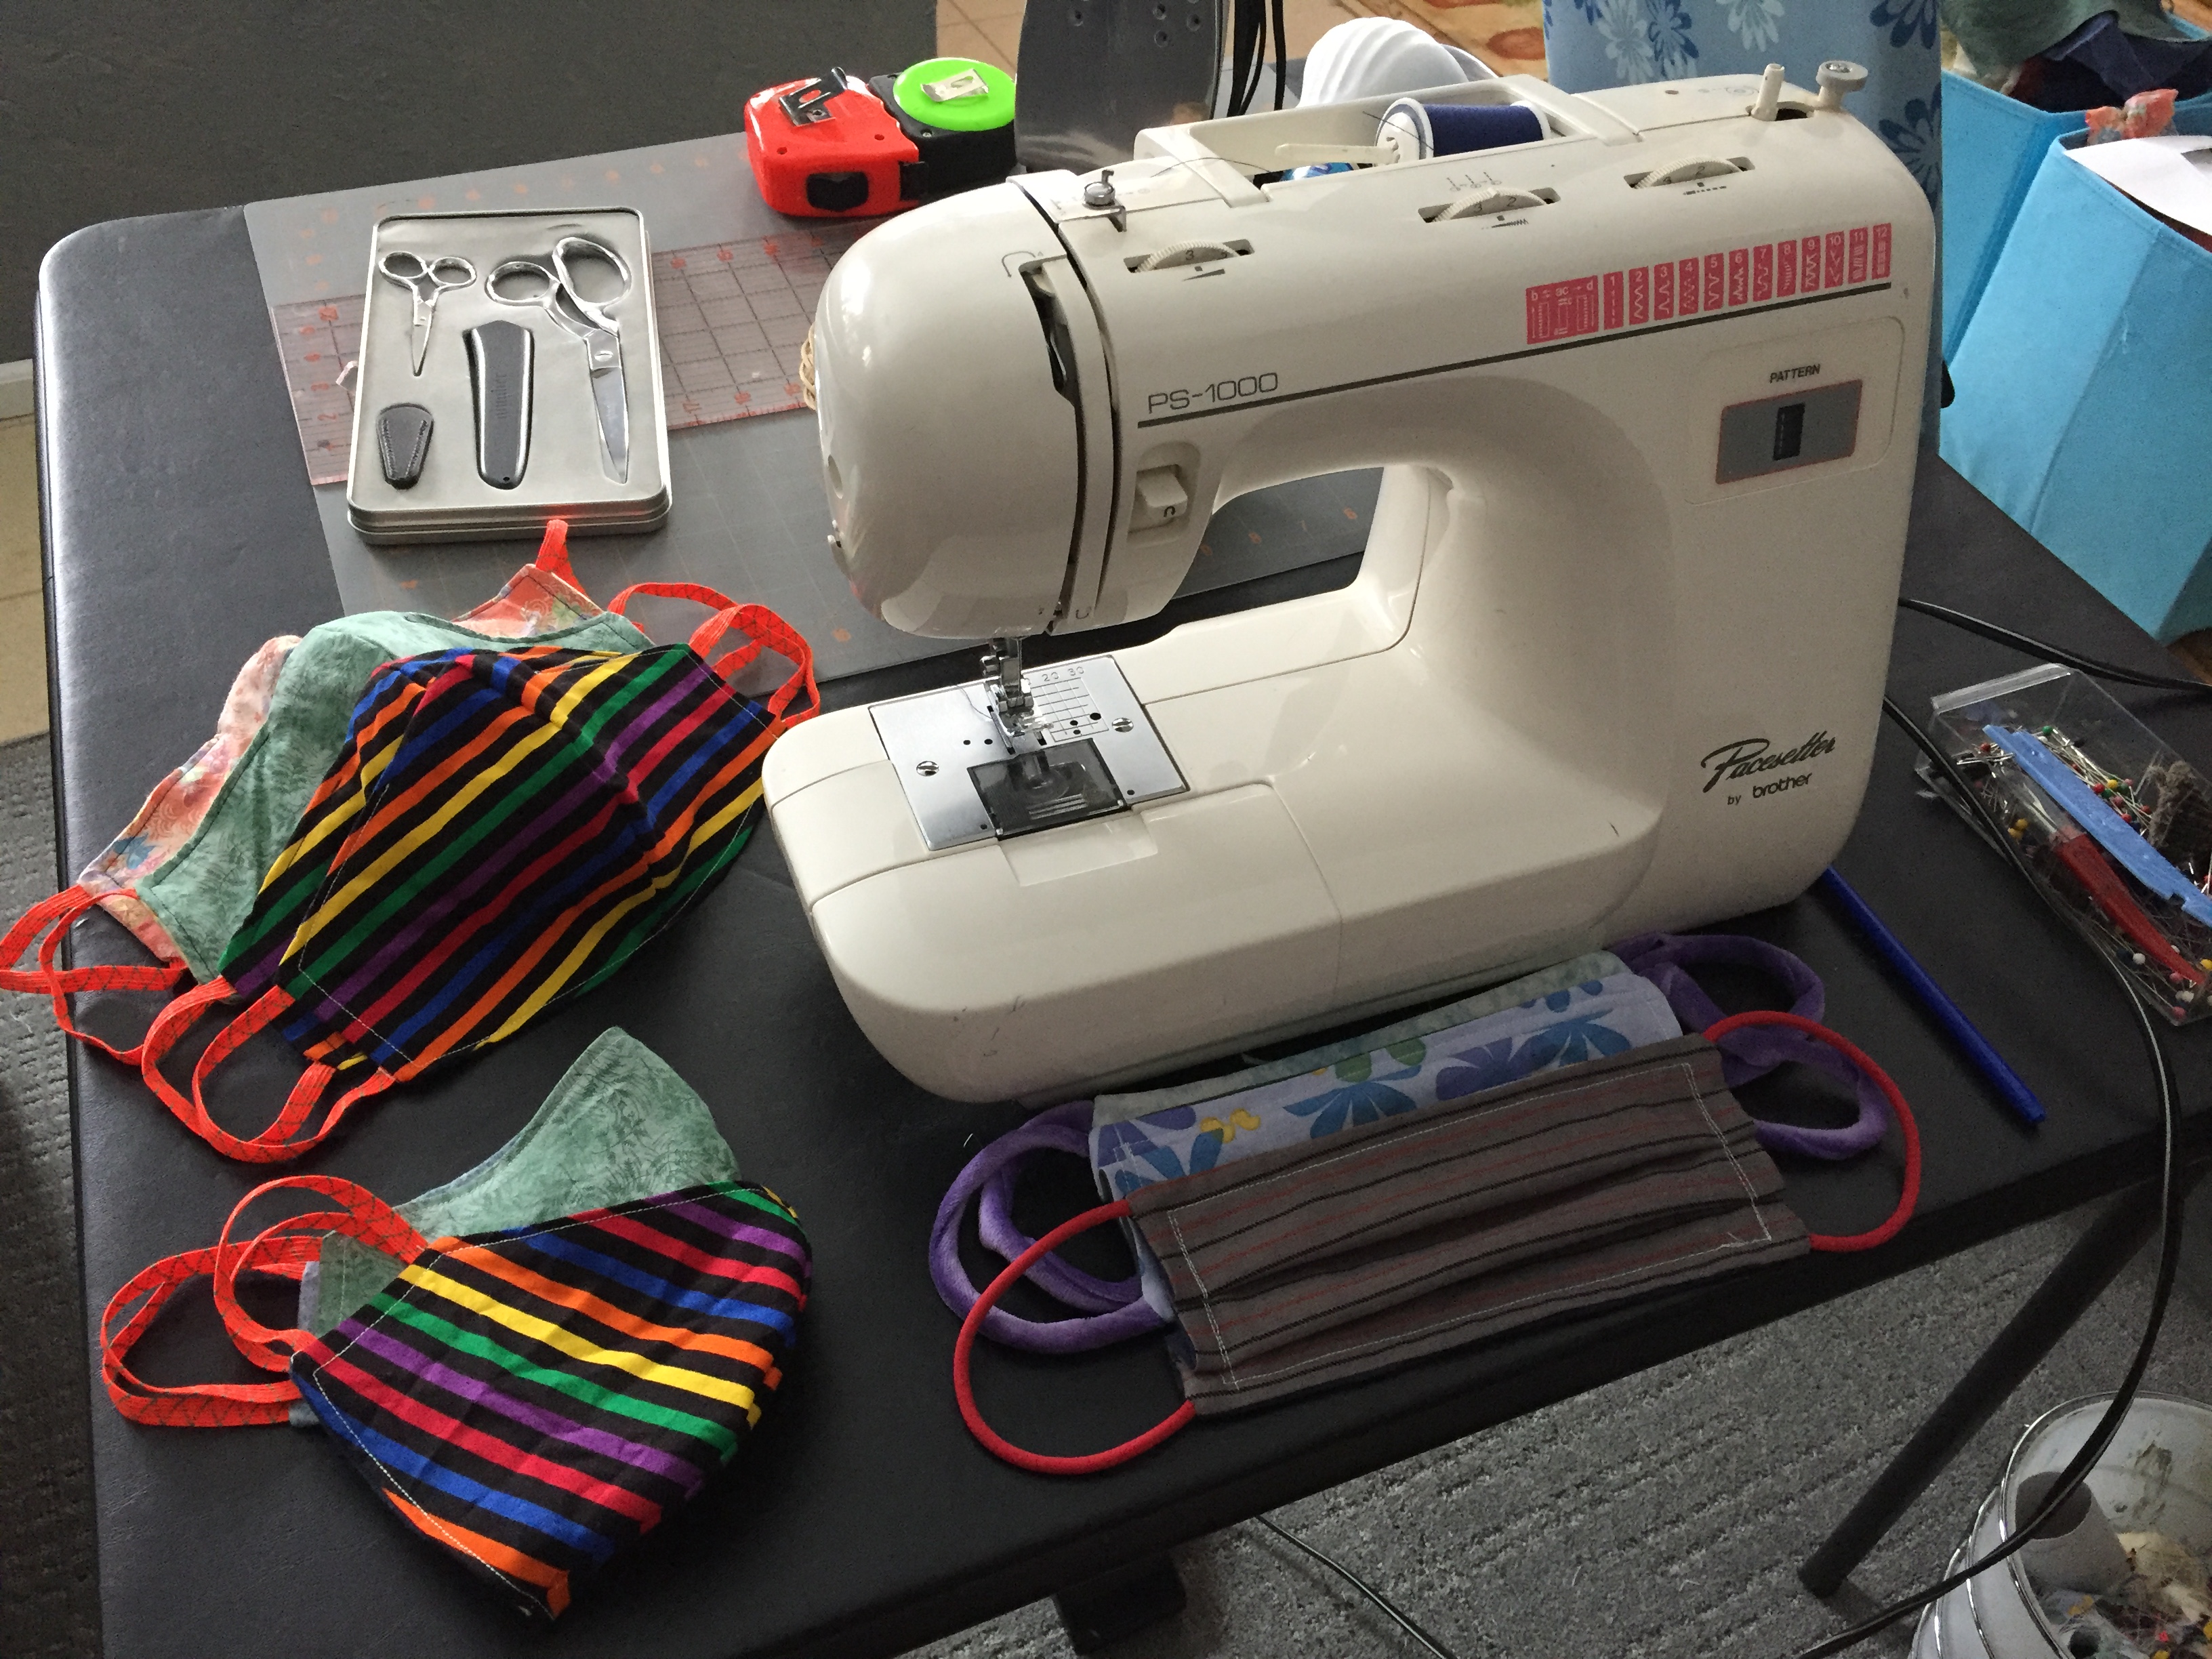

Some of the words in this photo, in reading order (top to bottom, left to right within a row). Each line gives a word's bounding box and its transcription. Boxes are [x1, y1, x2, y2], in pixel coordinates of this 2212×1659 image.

[1696, 165, 1705, 176] 2
[1474, 201, 1483, 214] 3
[1507, 195, 1517, 207] 2
[1185, 249, 1194, 261] 3
[1610, 275, 1616, 287] 1
[1635, 271, 1643, 282] 2
[1660, 266, 1668, 277] 3
[1685, 261, 1693, 272] 4
[1711, 256, 1718, 268] 5
[1735, 252, 1743, 264] 6
[1760, 248, 1767, 259] 7
[1784, 243, 1791, 255] 8
[1807, 239, 1815, 250] 9
[1830, 234, 1841, 246] 10
[1854, 231, 1864, 242] 11
[1877, 226, 1888, 237] 12
[1531, 289, 1538, 302] b
[1586, 279, 1593, 291] d
[1769, 364, 1821, 384] PATTERN
[1148, 372, 1278, 414] PS-1000
[1042, 671, 1059, 682] 20
[1067, 665, 1084, 676] 30
[1700, 731, 1836, 793] Pacesetter
[1727, 794, 1742, 805] by
[1753, 773, 1813, 798] brother
